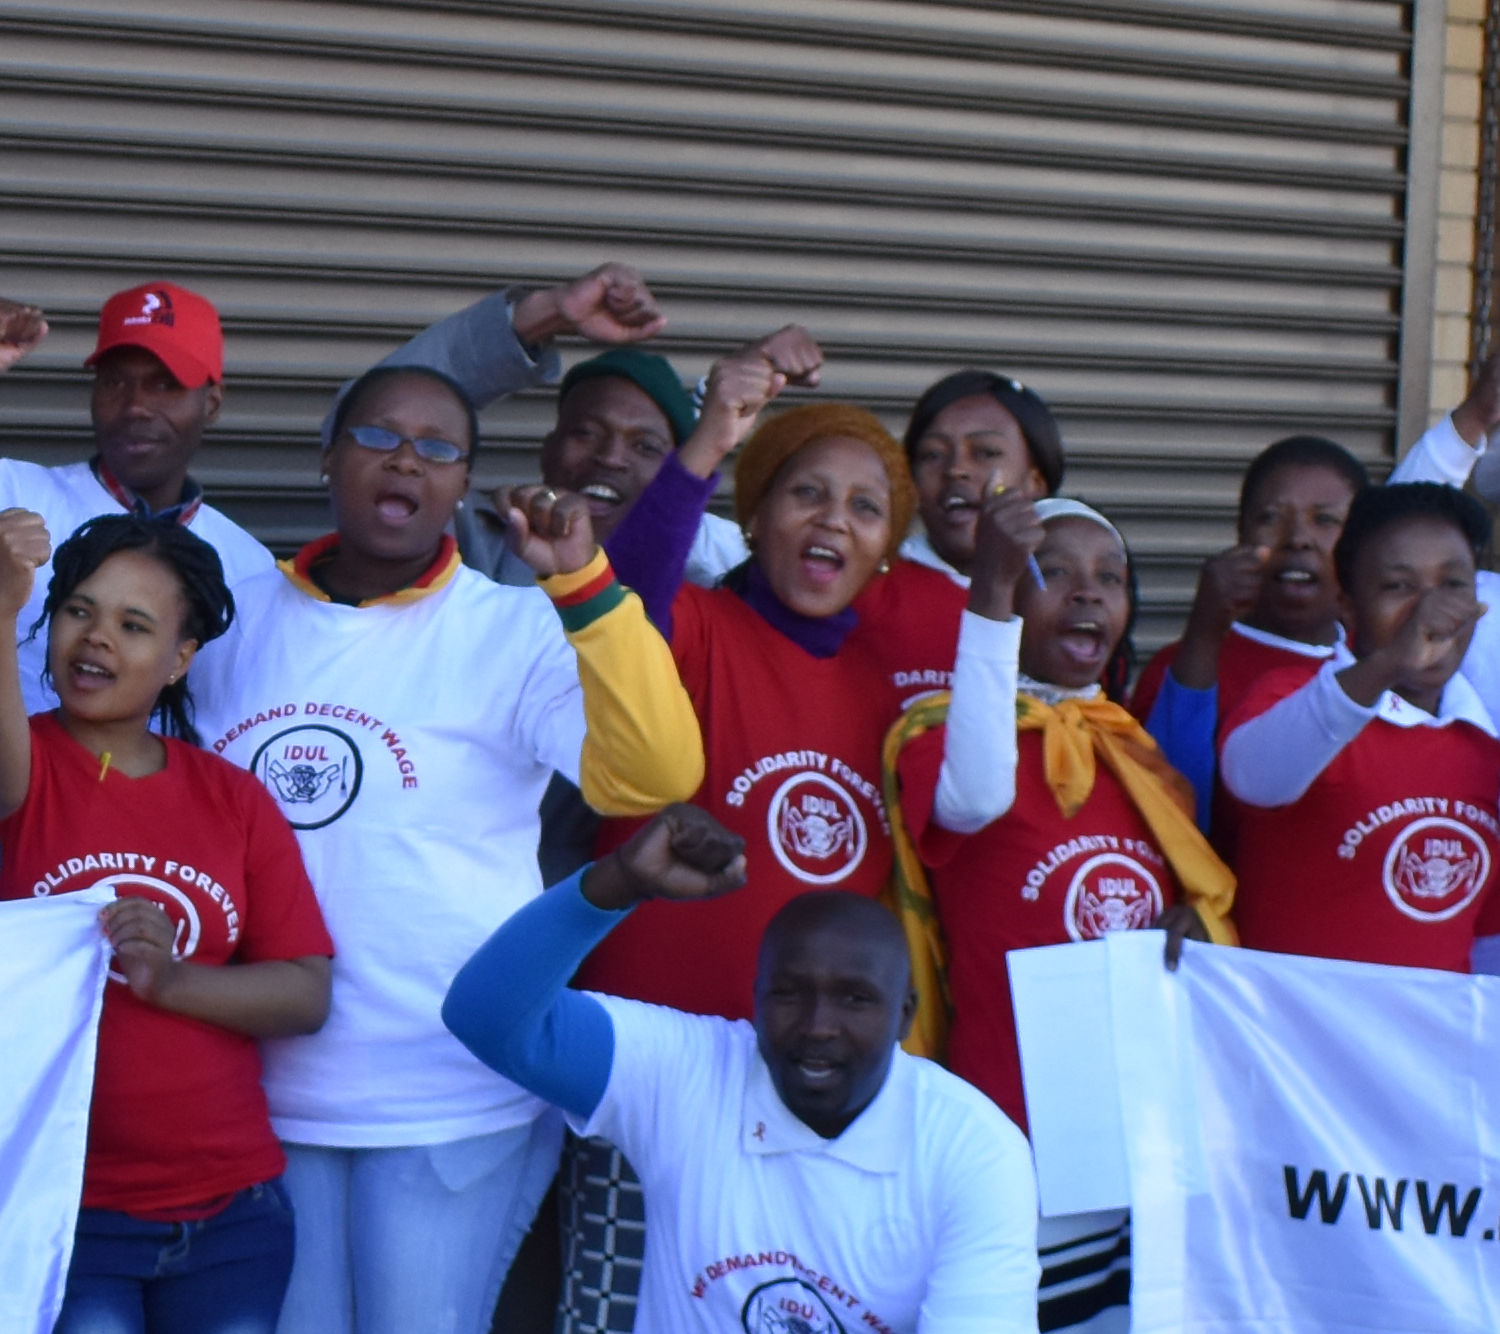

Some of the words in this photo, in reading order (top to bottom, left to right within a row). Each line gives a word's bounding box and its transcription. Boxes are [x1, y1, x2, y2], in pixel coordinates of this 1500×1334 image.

[212, 702, 297, 754] DEMAND
[303, 701, 383, 732] DECENT
[380, 727, 419, 789] WAGE
[283, 744, 329, 762] IDUL
[726, 750, 828, 808] SOLIDARITY
[801, 794, 843, 819] IDUL
[1337, 796, 1449, 860] SOLIDARITY
[1424, 838, 1468, 858] IDUL
[1021, 835, 1119, 902] SOLIDARITY
[33, 851, 156, 898] OLIDARITY
[163, 859, 240, 944] FOREVER
[1098, 877, 1142, 898] IDUL
[705, 1250, 789, 1281] DEMAND
[779, 1297, 821, 1322] IDU
